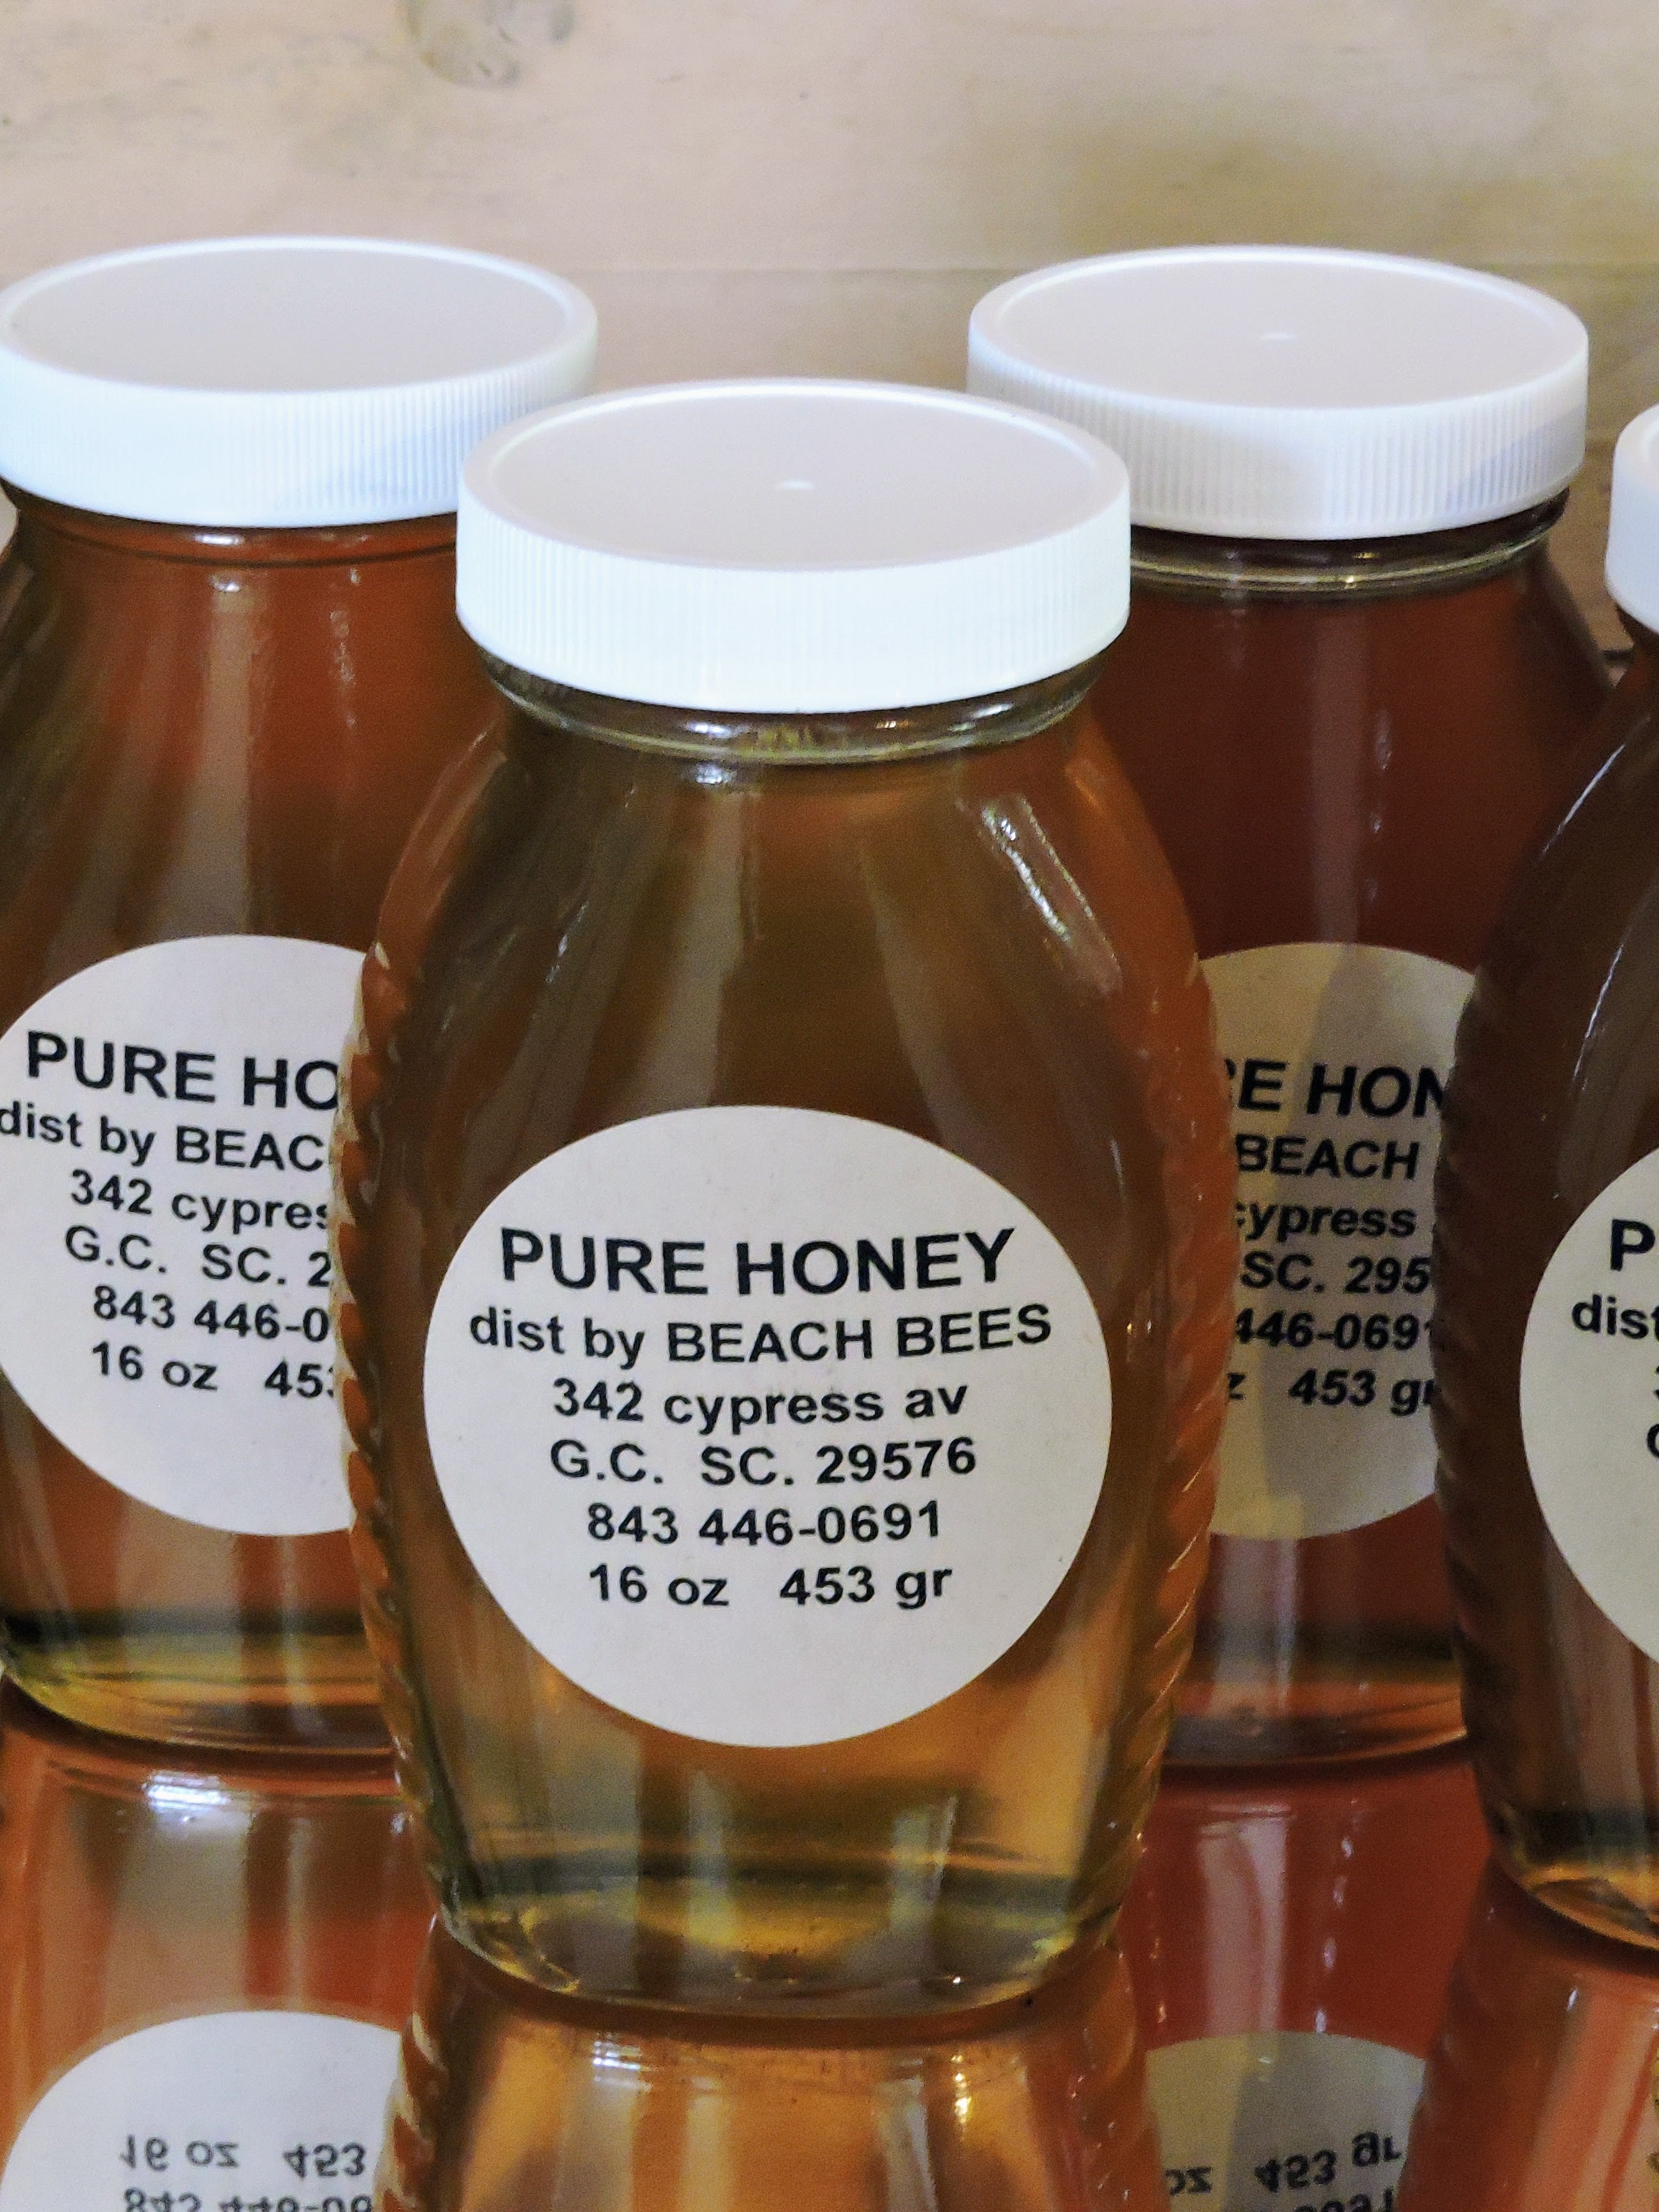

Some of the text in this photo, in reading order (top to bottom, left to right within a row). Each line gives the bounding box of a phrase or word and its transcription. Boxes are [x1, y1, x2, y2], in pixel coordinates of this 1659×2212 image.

[28, 1031, 338, 1110] PURE HO
[0, 1101, 323, 1172] dist by BEAC
[1234, 1134, 1419, 1179] BEACH
[72, 1169, 152, 1215] 342
[65, 1226, 331, 1287] G.C. SC. 2
[502, 1228, 1014, 1295] PURE HONEY
[1242, 1251, 1324, 1292] SC.
[94, 1285, 332, 1342] 843 446-0
[470, 1304, 1051, 1370] dist by BEACH BEES
[93, 1342, 333, 1398] 16 oz 45
[1288, 1369, 1375, 1406] 453
[554, 1378, 967, 1435] 342 cypress av
[551, 1437, 975, 1486] G.C. SC. 29576
[588, 1500, 938, 1546] 843 446-0691
[590, 1564, 952, 1610] 16 oz 453 gr
